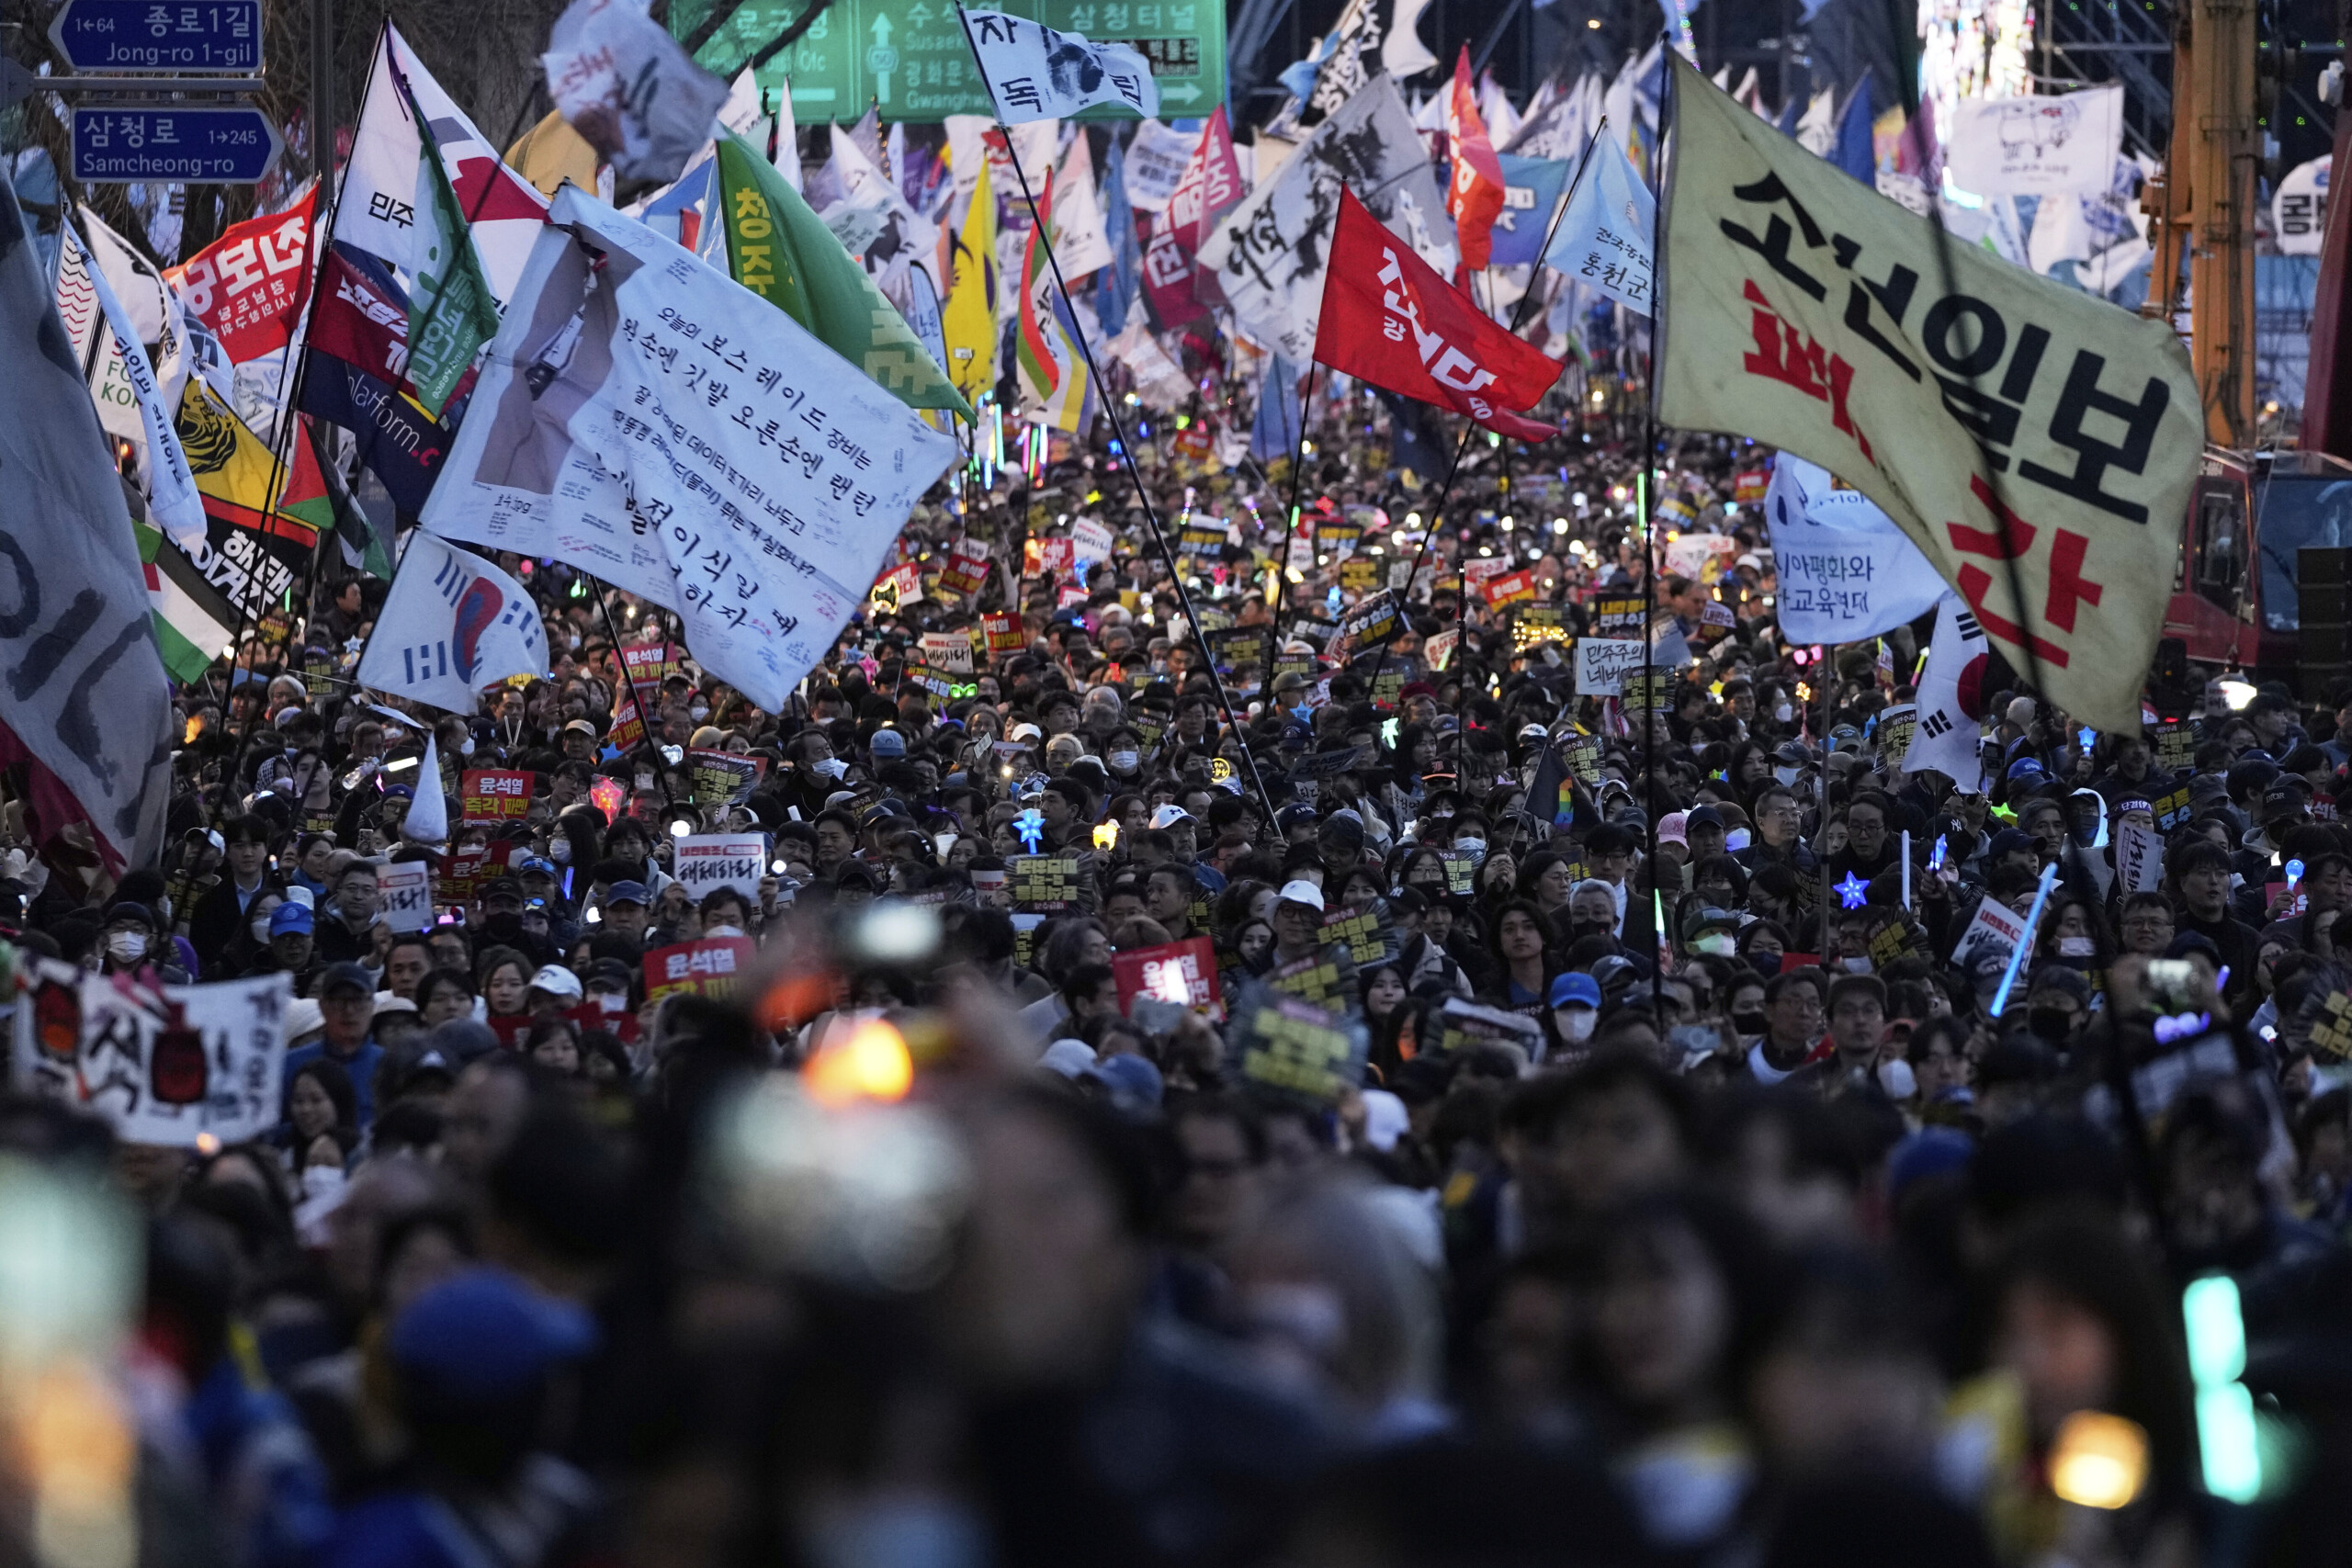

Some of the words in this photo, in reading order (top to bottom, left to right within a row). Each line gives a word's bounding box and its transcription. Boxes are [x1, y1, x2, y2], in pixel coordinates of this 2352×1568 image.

[75, 18, 82, 32] 1
[96, 18, 115, 33] 64
[144, 6, 250, 37] 종로1길
[1070, 4, 1196, 32] 삼청터널
[107, 43, 194, 65] Jong-ro
[202, 43, 251, 66] 1-gil
[84, 116, 180, 148] 삼청로
[209, 130, 215, 144] 1
[231, 130, 257, 144] 245
[84, 153, 234, 176] Samcheong-ro
[1581, 252, 1649, 300] 홍천군
[1720, 170, 2171, 525] 조선일보
[658, 308, 702, 340] 오늘의
[702, 333, 748, 373] 보스
[755, 367, 827, 433] 레이드
[826, 428, 873, 471] 장비는
[730, 406, 823, 479] 오른손엔
[829, 472, 876, 517] 랜턴
[223, 529, 294, 597] 해태
[627, 648, 663, 665] 윤석열
[1586, 644, 1645, 666] 민주주의
[1587, 667, 1626, 688] 네버
[480, 777, 524, 795] 윤석열
[465, 796, 500, 816] 즉각
[503, 797, 529, 816] 파면!
[678, 858, 763, 885] 해체하라!
[666, 947, 737, 980] 윤석열
